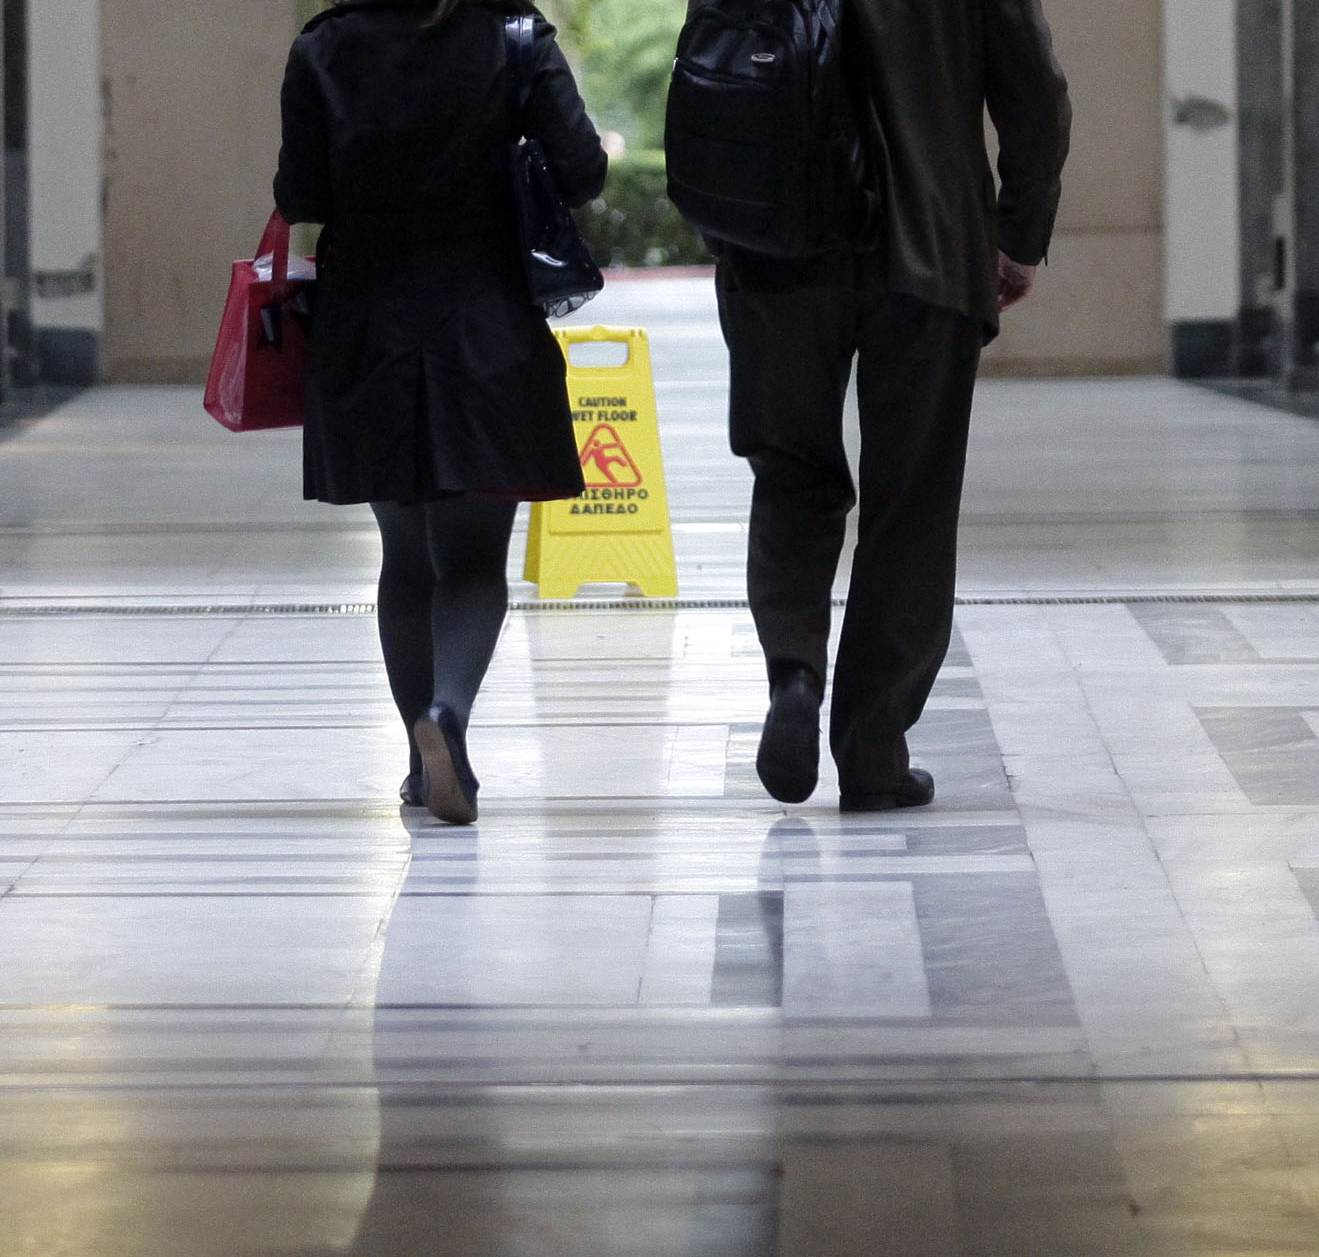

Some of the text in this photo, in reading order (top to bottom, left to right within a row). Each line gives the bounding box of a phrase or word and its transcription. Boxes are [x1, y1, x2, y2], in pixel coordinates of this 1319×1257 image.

[578, 396, 627, 408] CAUTION
[597, 410, 637, 422] FLOOR
[574, 488, 649, 500] ΙΣΘΗΡΟ
[570, 503, 639, 515] ΔΑΠΕΔΟ
